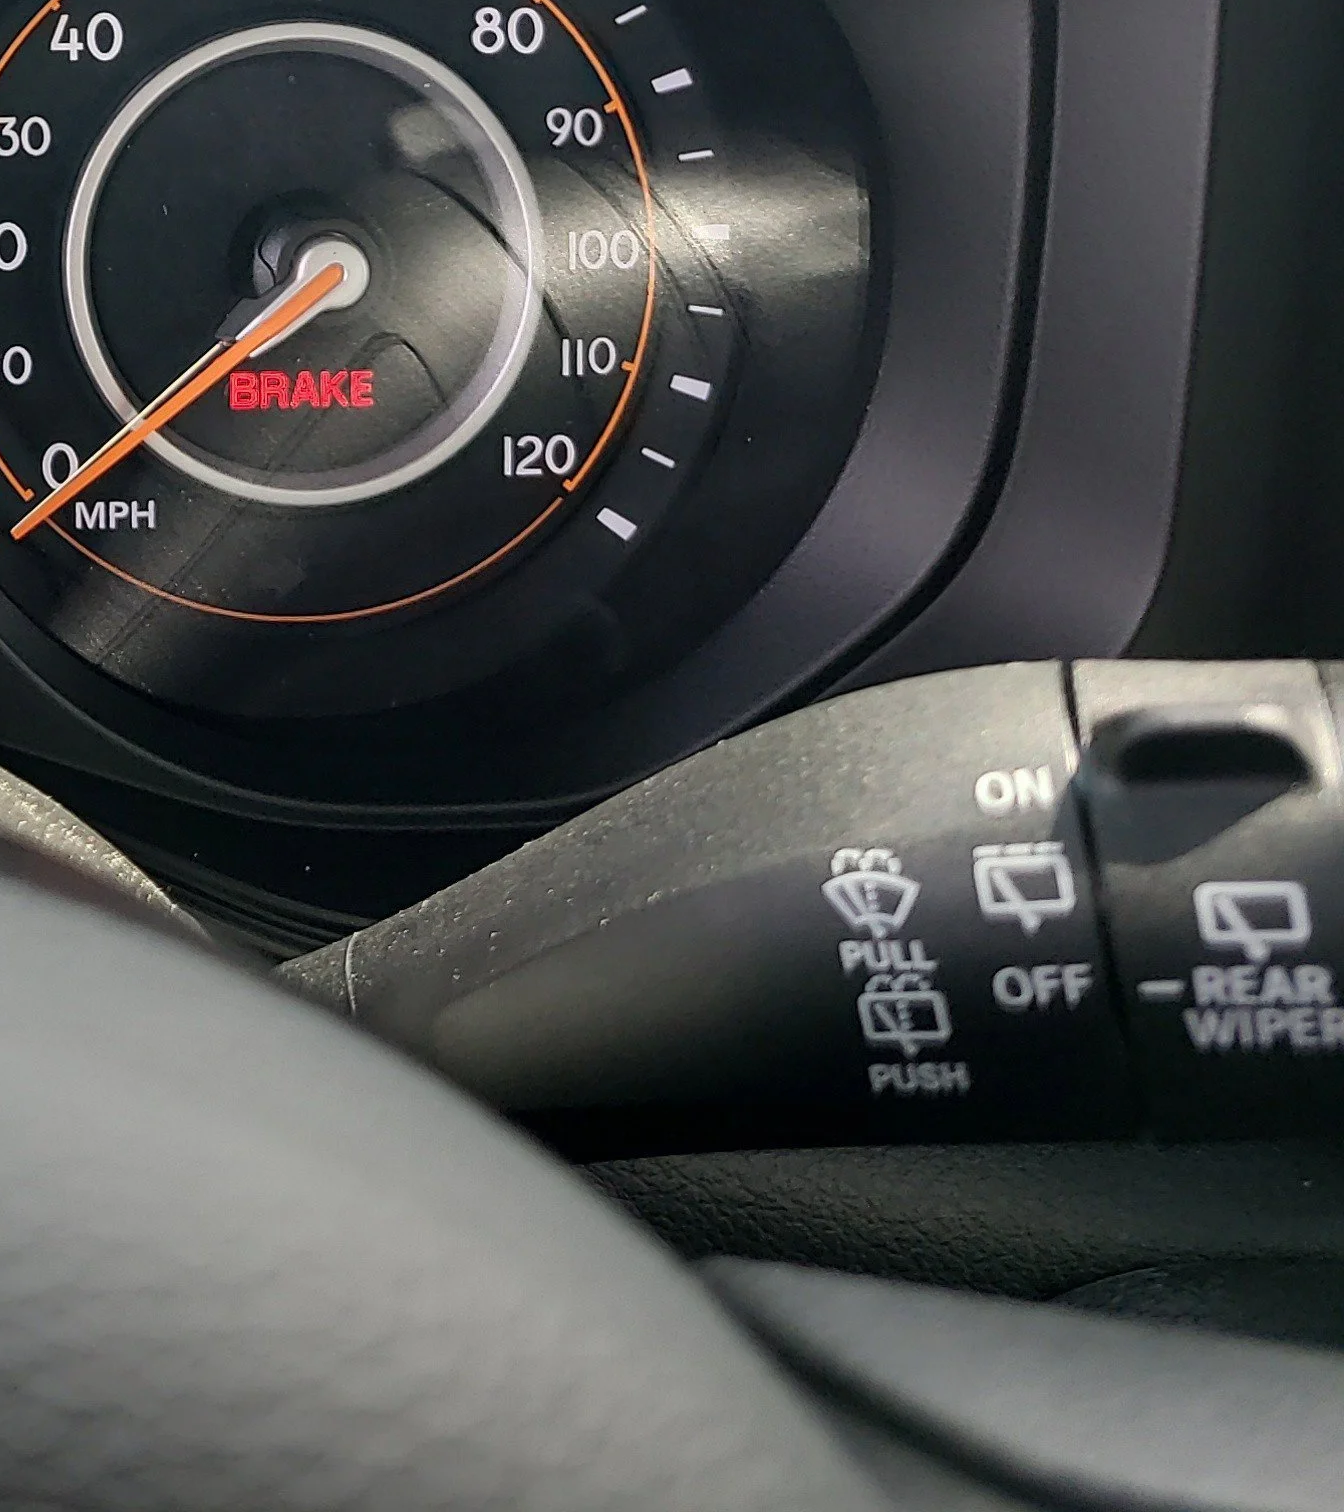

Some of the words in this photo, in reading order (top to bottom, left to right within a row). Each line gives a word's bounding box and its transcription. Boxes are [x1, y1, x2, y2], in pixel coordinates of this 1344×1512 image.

[50, 11, 124, 62] 40
[472, 6, 545, 55] 80
[546, 107, 603, 149] 90
[568, 231, 640, 270] 100
[562, 339, 617, 376] 110
[229, 369, 375, 410] BRAKE
[42, 442, 79, 490] 0
[503, 437, 575, 477] 120
[75, 500, 155, 530] MPH
[973, 767, 1054, 815] ON
[838, 939, 937, 974] PULL
[992, 963, 1092, 1013] OFF
[1191, 964, 1334, 1008] REAR
[868, 1061, 971, 1094] PUSH
